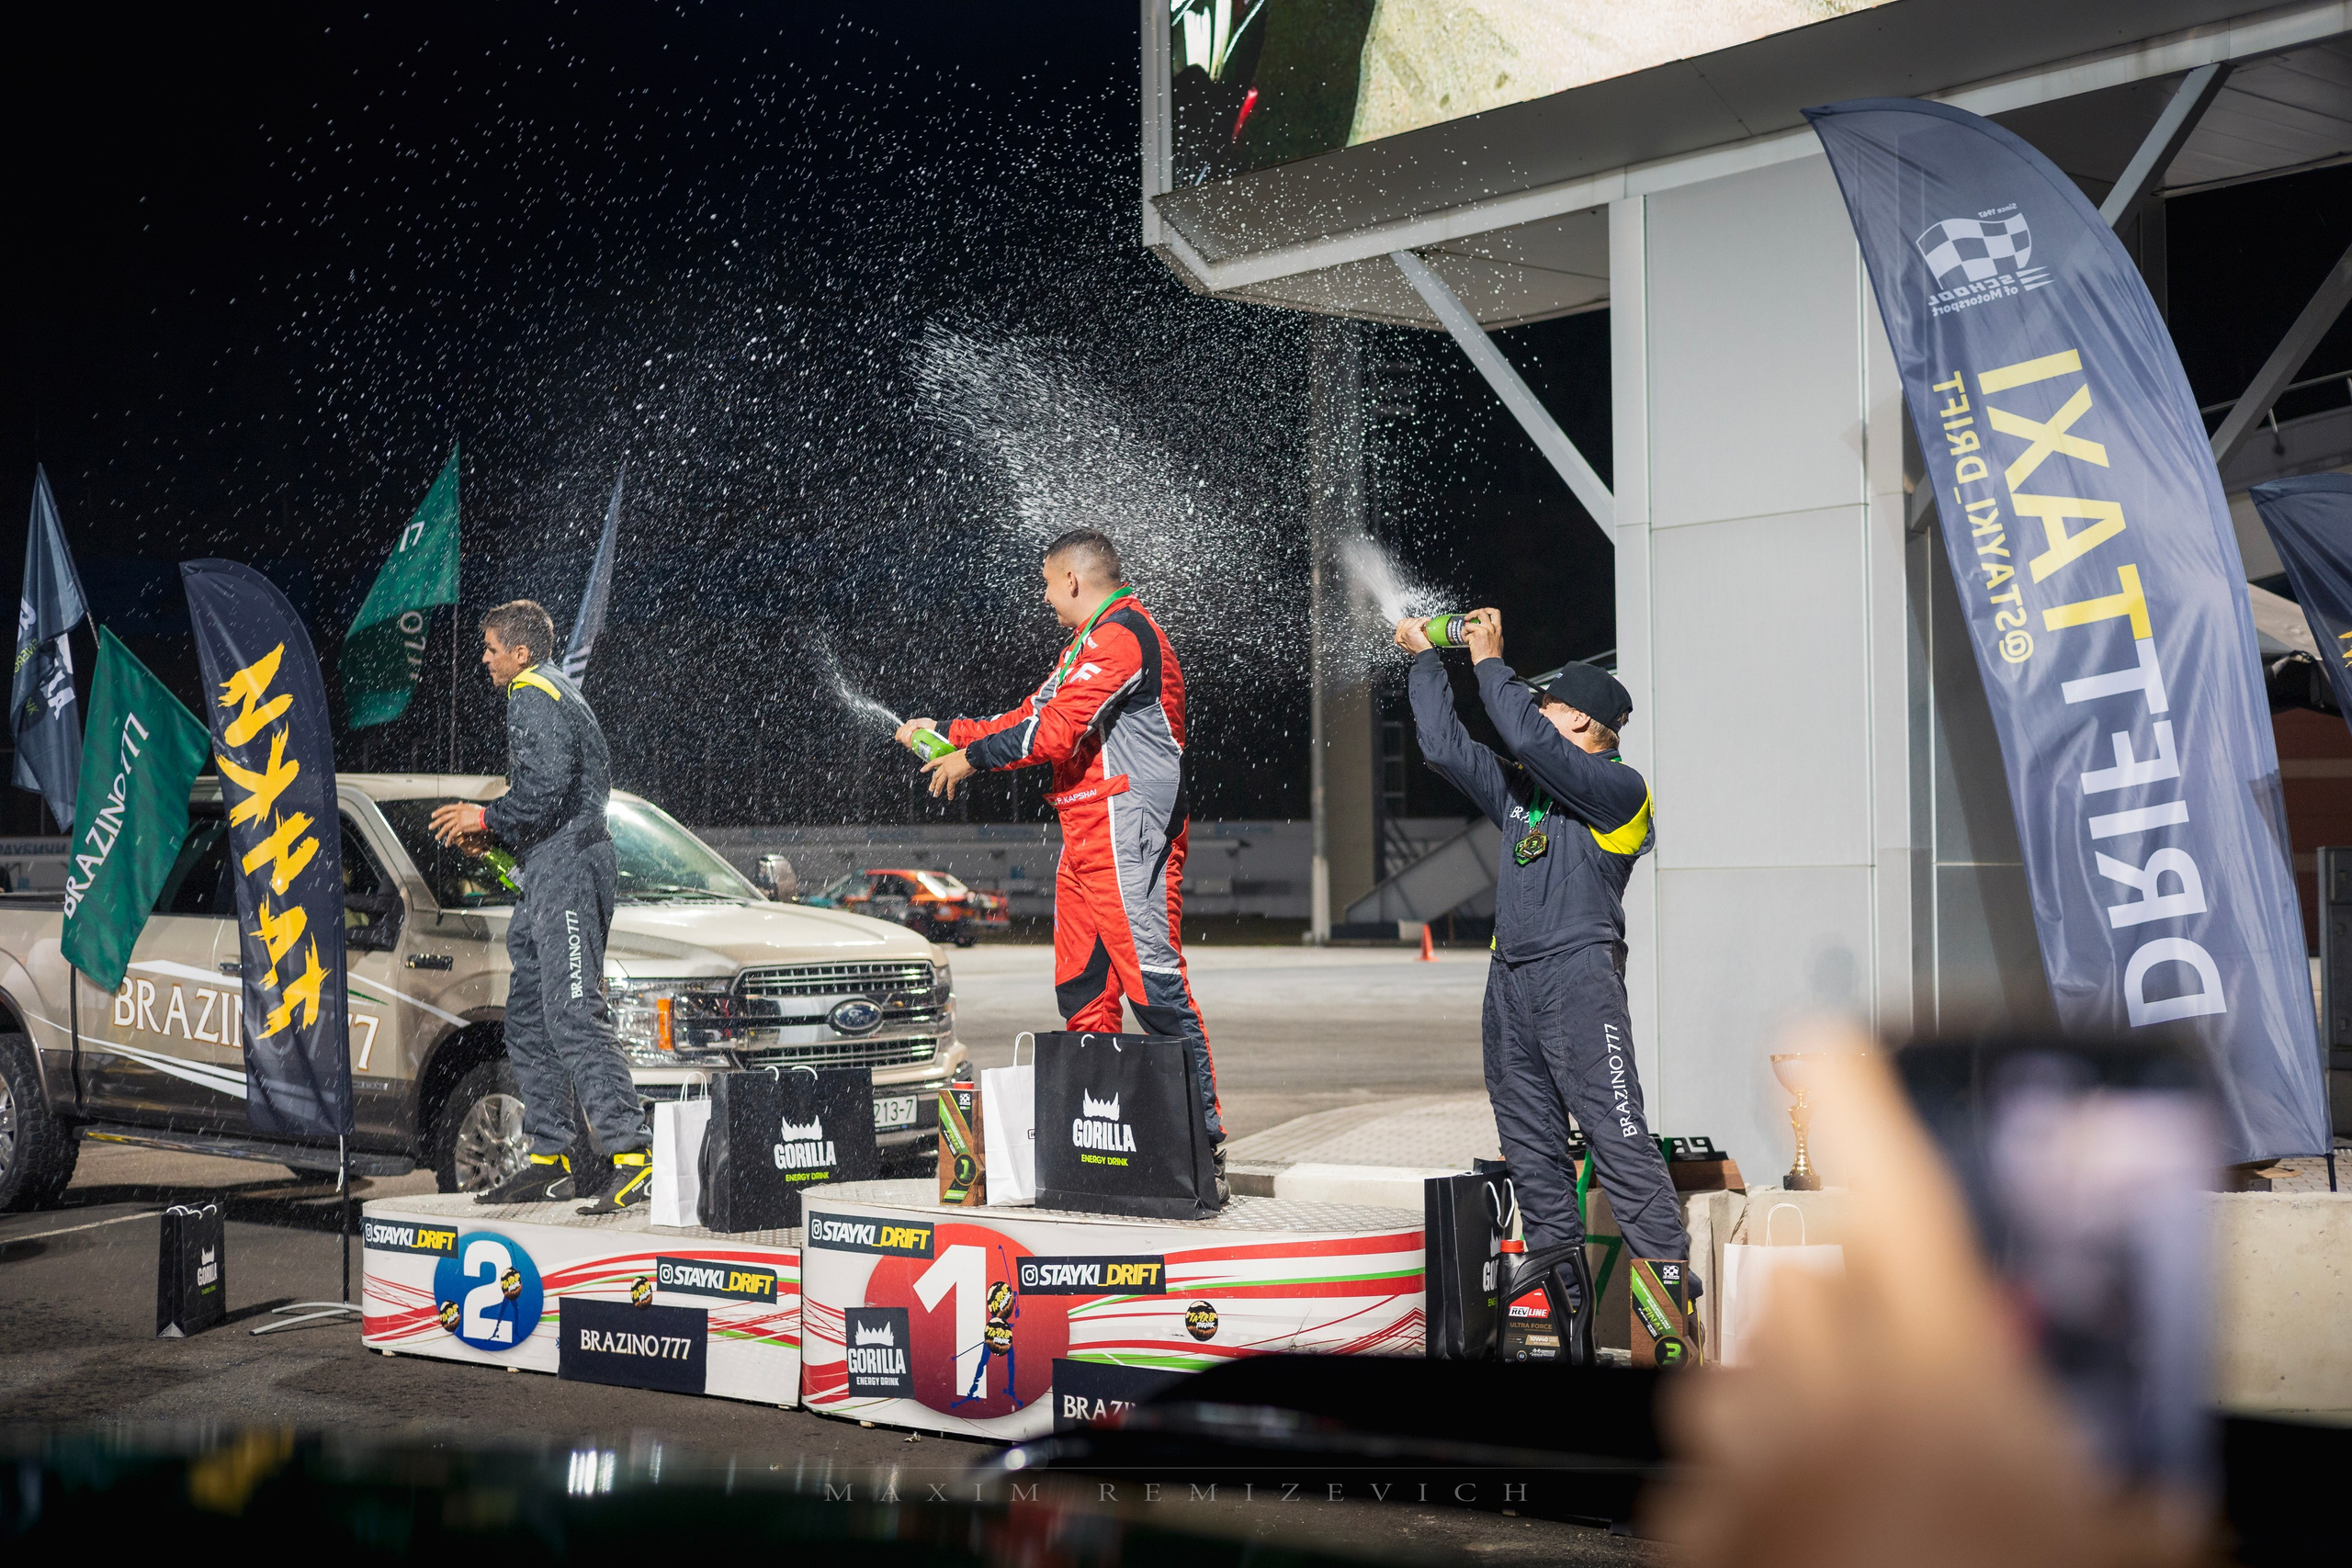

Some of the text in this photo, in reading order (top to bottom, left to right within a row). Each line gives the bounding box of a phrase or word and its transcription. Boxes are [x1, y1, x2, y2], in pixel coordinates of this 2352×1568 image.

[63, 712, 150, 919] BRAZINO777
[565, 909, 583, 999] BRAZINO777
[1603, 1022, 1638, 1138] BRAZINO777
[1072, 1118, 1137, 1153] GORILLA
[773, 1141, 837, 1169] GORILLA
[1080, 1153, 1129, 1167] ENERGY DRINK
[785, 1172, 830, 1182] ENERGY DRINK
[372, 1224, 457, 1250] STAYKI_DRIFT
[821, 1221, 931, 1250] STAYKI_DRIFT
[673, 1265, 775, 1295] STAYKI_DRIFT
[1039, 1263, 1161, 1287] STAYKI_DRIFT
[463, 1239, 513, 1343] 2
[912, 1244, 987, 1399] 1
[580, 1328, 692, 1360] BRAZINO777
[1662, 1342, 1682, 1365] 3
[846, 1348, 907, 1374] GORILLA
[855, 1376, 899, 1387] ENERGY DRINK
